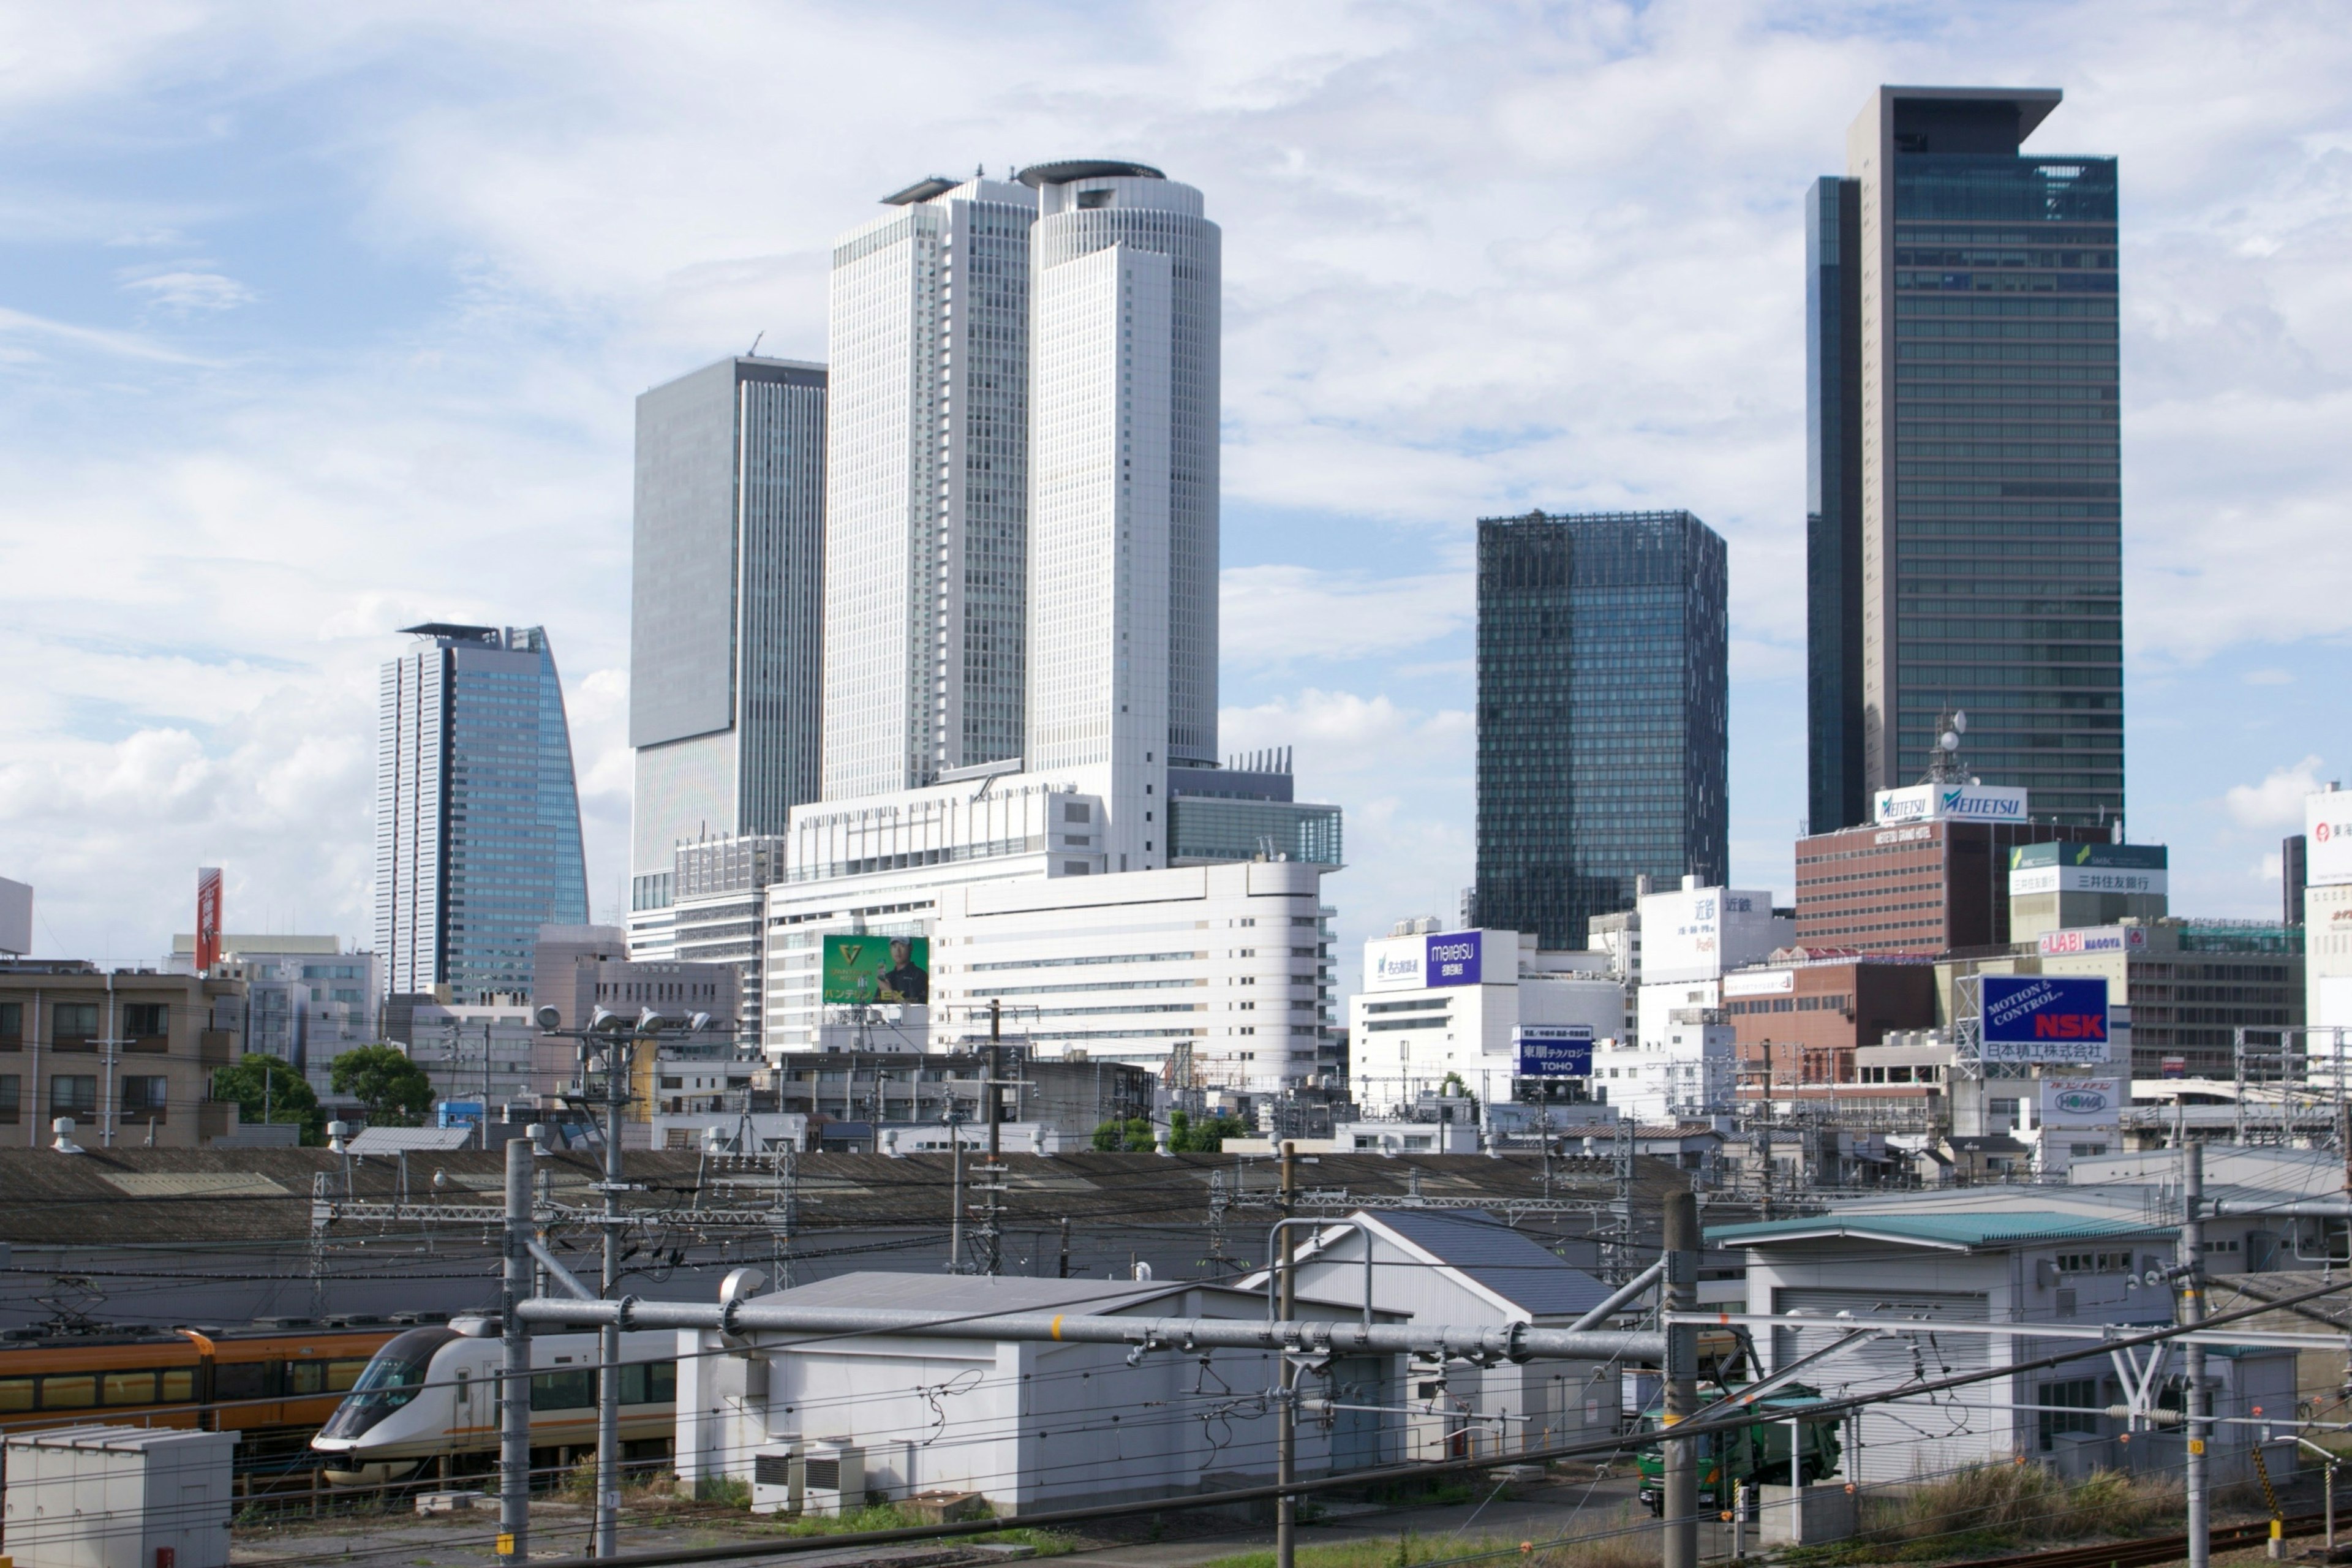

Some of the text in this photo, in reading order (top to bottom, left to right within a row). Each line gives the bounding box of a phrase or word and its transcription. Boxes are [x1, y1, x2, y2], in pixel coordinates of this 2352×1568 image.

[1880, 791, 1926, 818] MEITETSU
[1939, 786, 2019, 815] MEITETSU
[1875, 826, 1931, 845] MEITETSU GRAND HOTEL
[2021, 858, 2035, 867] SMBC
[2092, 856, 2112, 865] SMBC
[2015, 875, 2056, 891] 三井住友銀行
[2078, 875, 2149, 890] 三井住友銀行
[1725, 897, 1752, 912] 近鉄
[2049, 932, 2120, 953] LABI NAGOYA
[881, 990, 905, 1000] EX
[1987, 979, 2052, 1016] MOTION &
[2035, 1014, 2105, 1038] NSK
[1523, 1045, 1591, 1058] 東朋テクノロジー
[1988, 1044, 2102, 1058] 日本精工株式会社
[1540, 1061, 1573, 1071] TOHO
[2060, 1095, 2101, 1108] HOWA
[610, 1494, 615, 1504] 7
